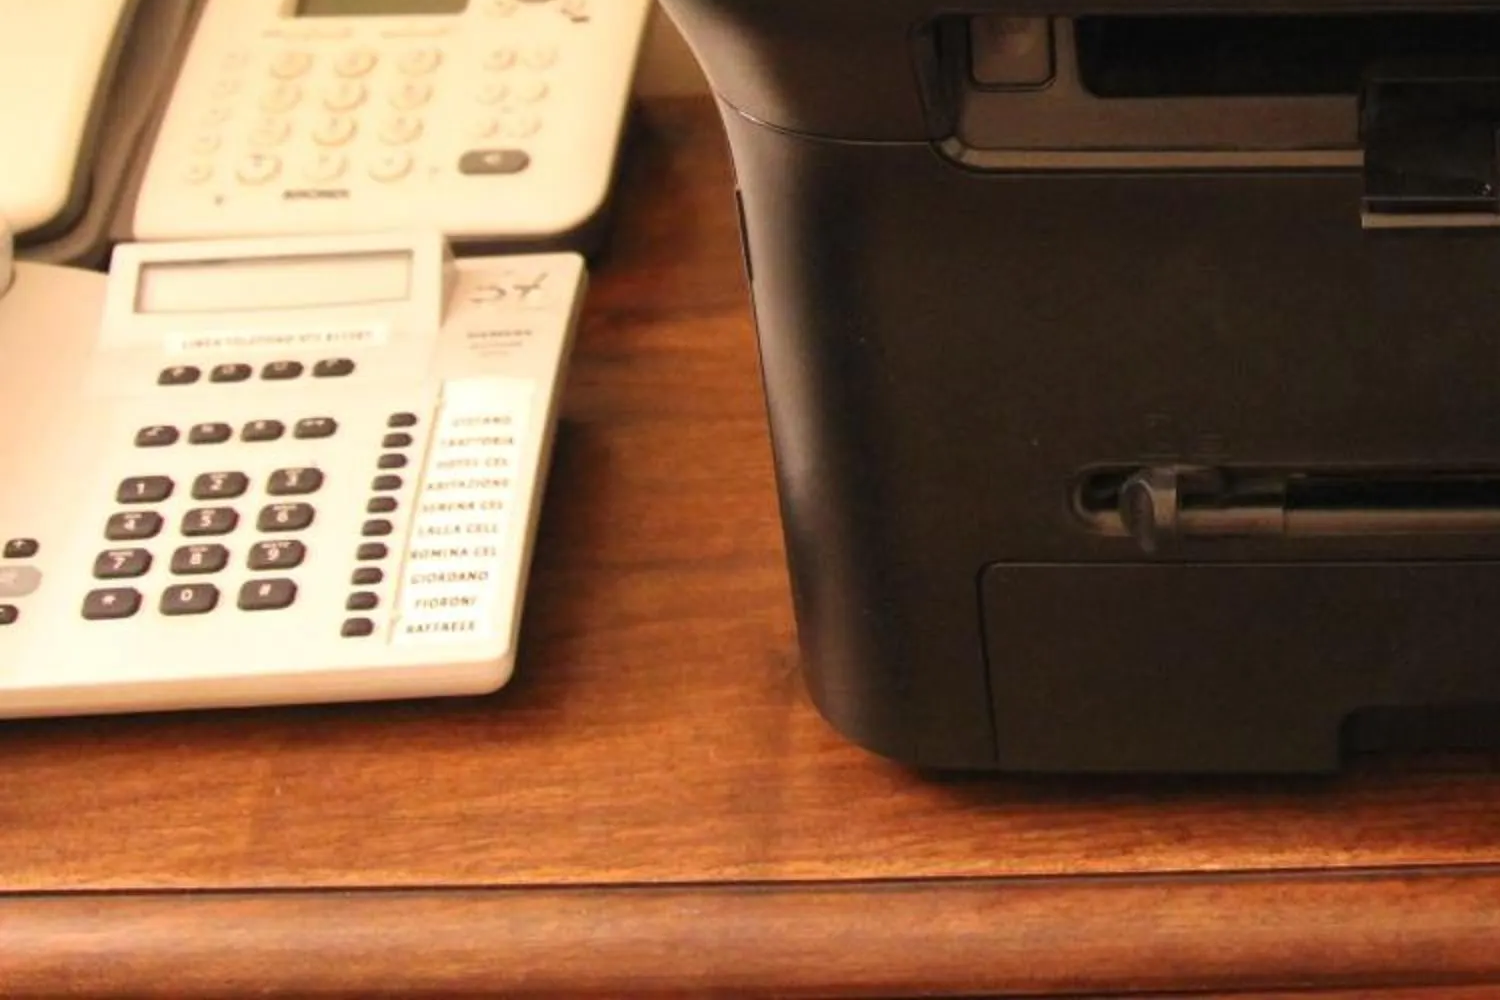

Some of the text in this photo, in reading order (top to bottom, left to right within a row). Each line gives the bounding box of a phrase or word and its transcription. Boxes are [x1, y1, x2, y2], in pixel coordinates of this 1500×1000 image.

[135, 482, 146, 496] 1
[276, 509, 289, 523] 6
[112, 556, 126, 571] 7
[266, 546, 281, 561] 9
